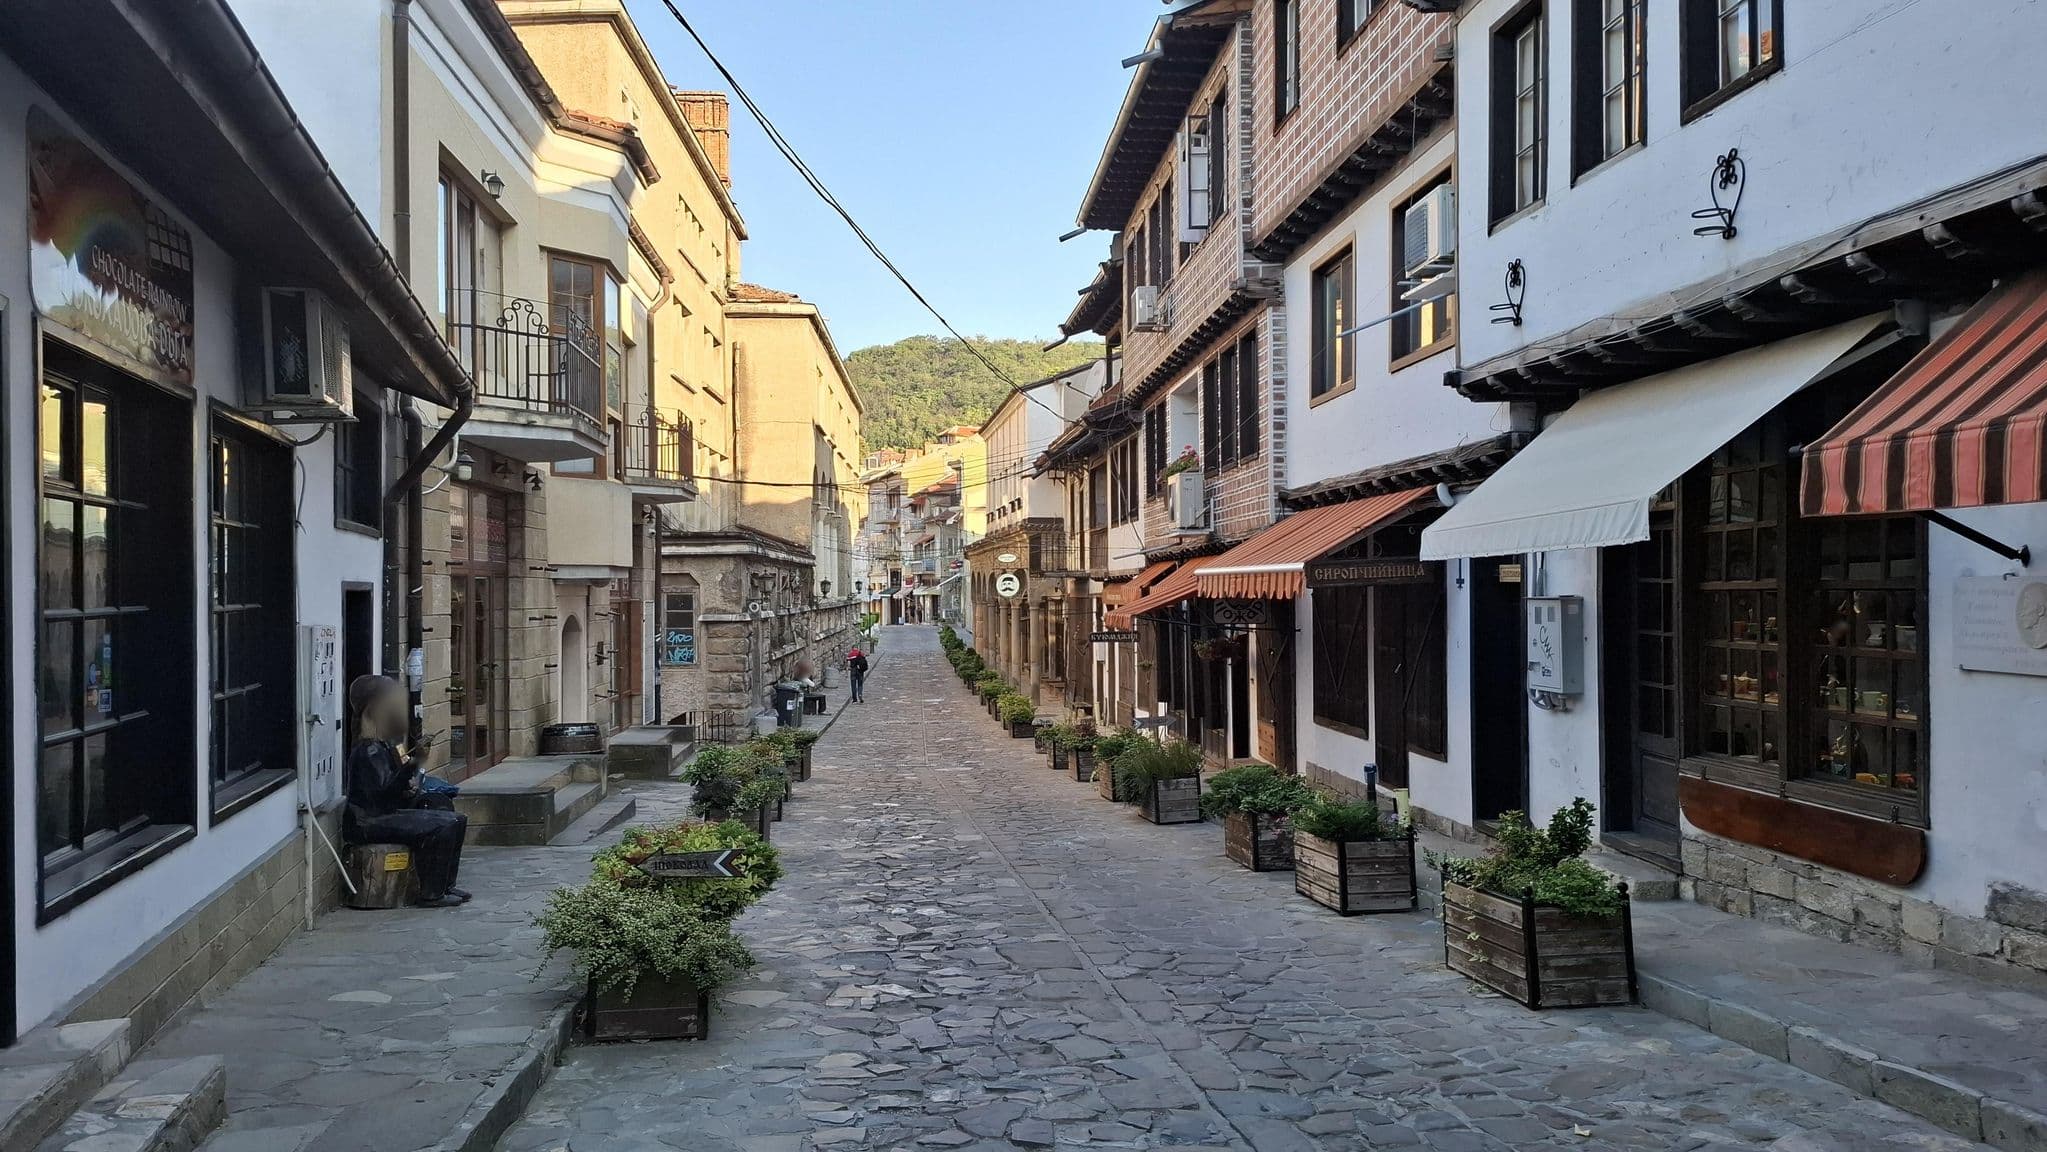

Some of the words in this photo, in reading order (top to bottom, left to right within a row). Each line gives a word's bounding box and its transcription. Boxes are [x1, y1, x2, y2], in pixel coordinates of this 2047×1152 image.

[92, 245, 147, 299] CHOCOLATE
[159, 321, 188, 367] ДЪГА
[1314, 562, 1425, 580] СИРОПЧИЙНИЦА
